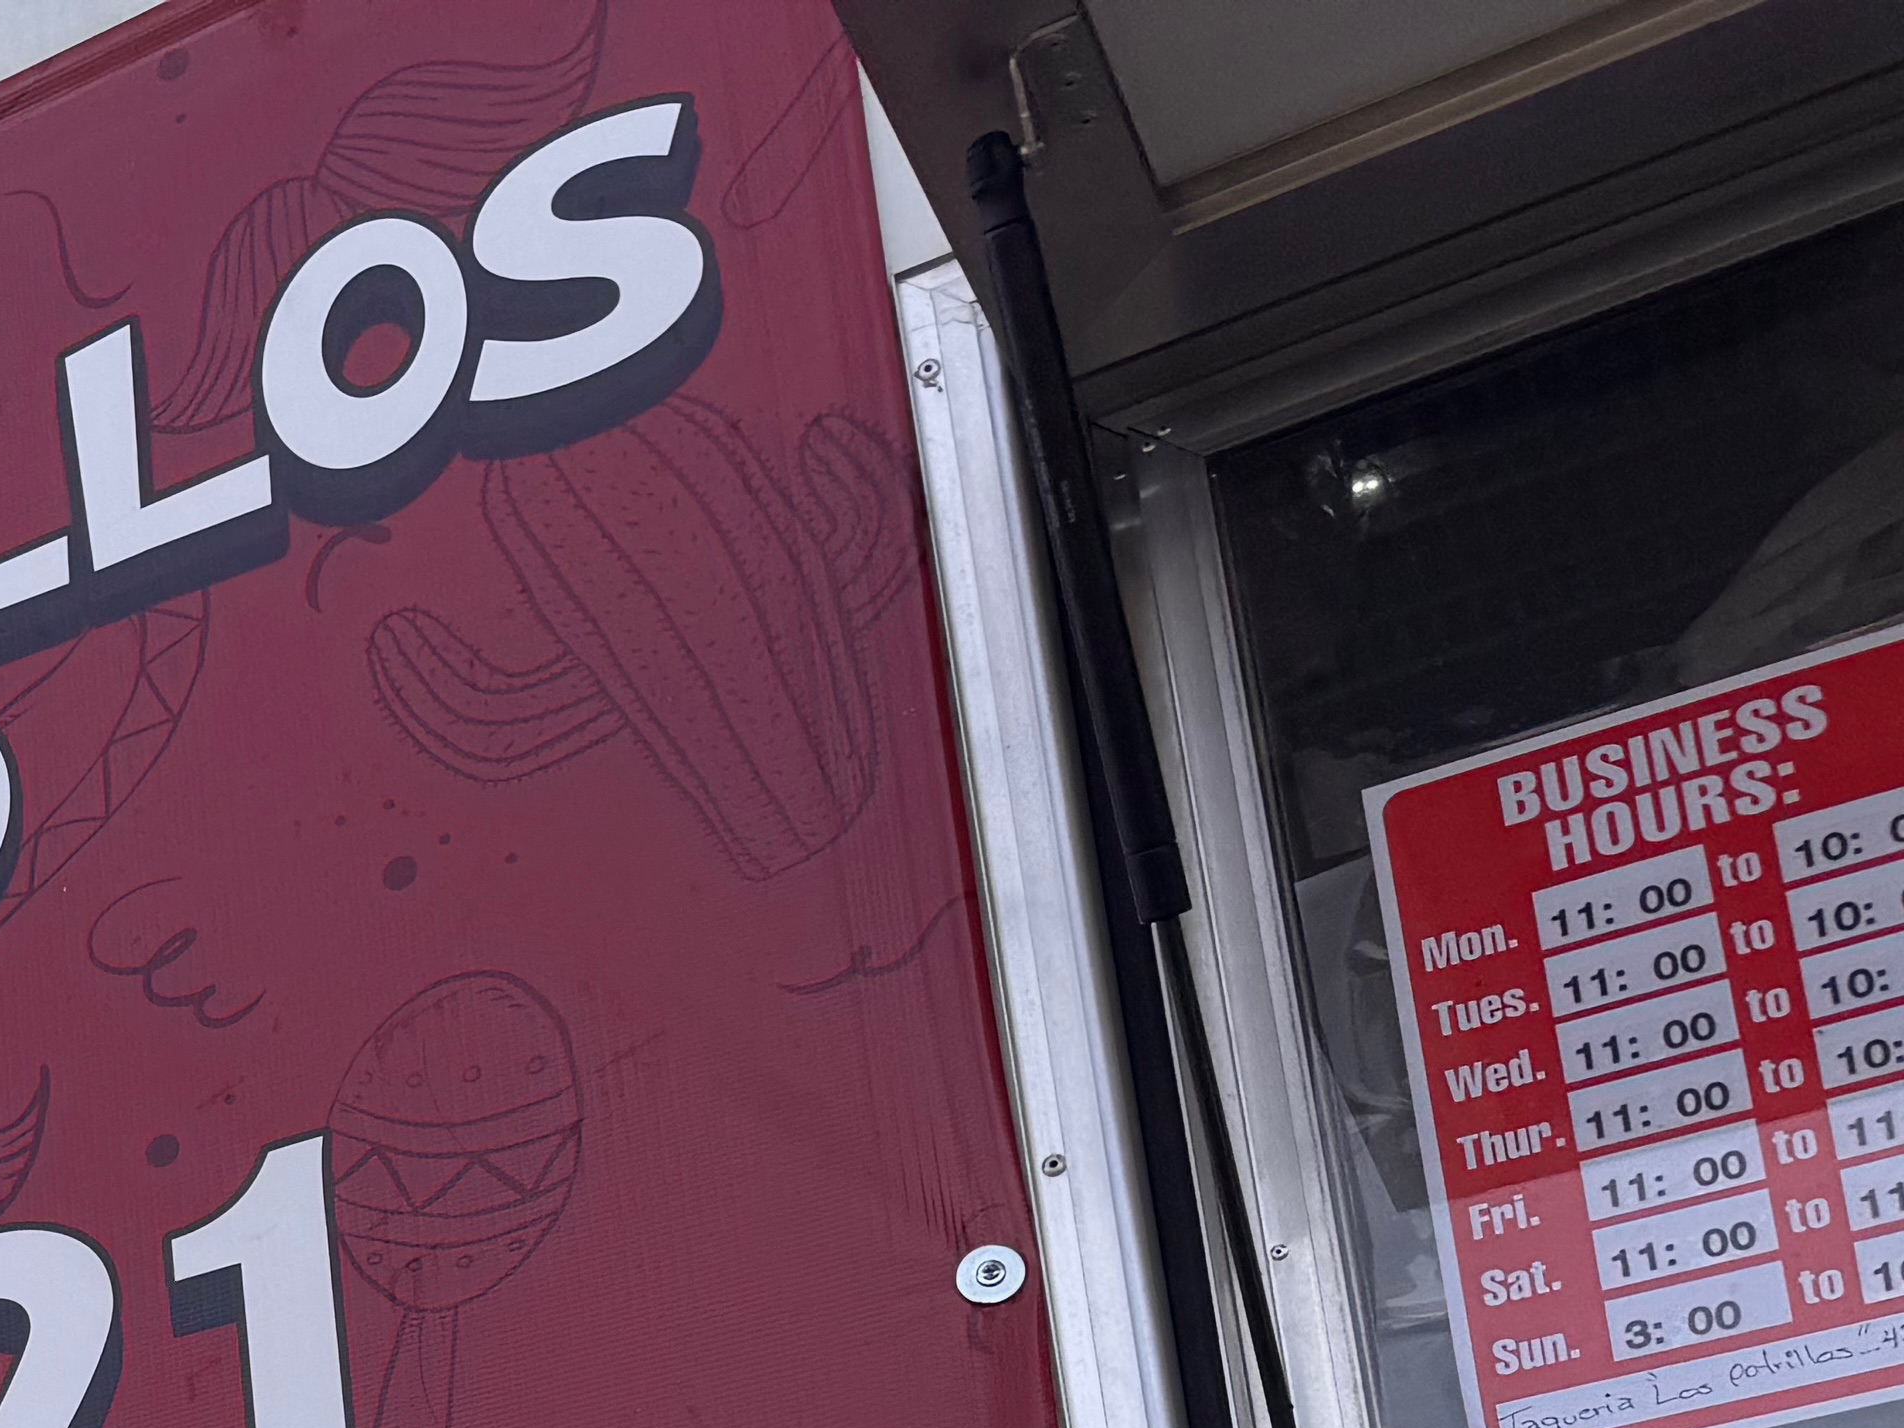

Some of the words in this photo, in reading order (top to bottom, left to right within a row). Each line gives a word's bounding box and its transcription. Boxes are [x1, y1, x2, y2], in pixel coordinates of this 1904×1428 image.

[1497, 685, 1827, 826] BUSINESS
[1545, 761, 1801, 871] HOURS:
[1421, 924, 1518, 971] Mon.
[1718, 851, 1762, 887] to
[1433, 988, 1540, 1036] Tues.
[1730, 918, 1775, 955] to
[1445, 1049, 1546, 1102] Wed.
[1746, 987, 1790, 1023] to
[1457, 1121, 1566, 1170] Thur.
[1759, 1058, 1804, 1093] to
[1468, 1195, 1541, 1240] Fri.
[1772, 1128, 1817, 1165] to
[1481, 1261, 1562, 1306] Sat.
[1785, 1198, 1830, 1233] to
[1492, 1333, 1581, 1376] Sun.
[1798, 1268, 1844, 1304] to
